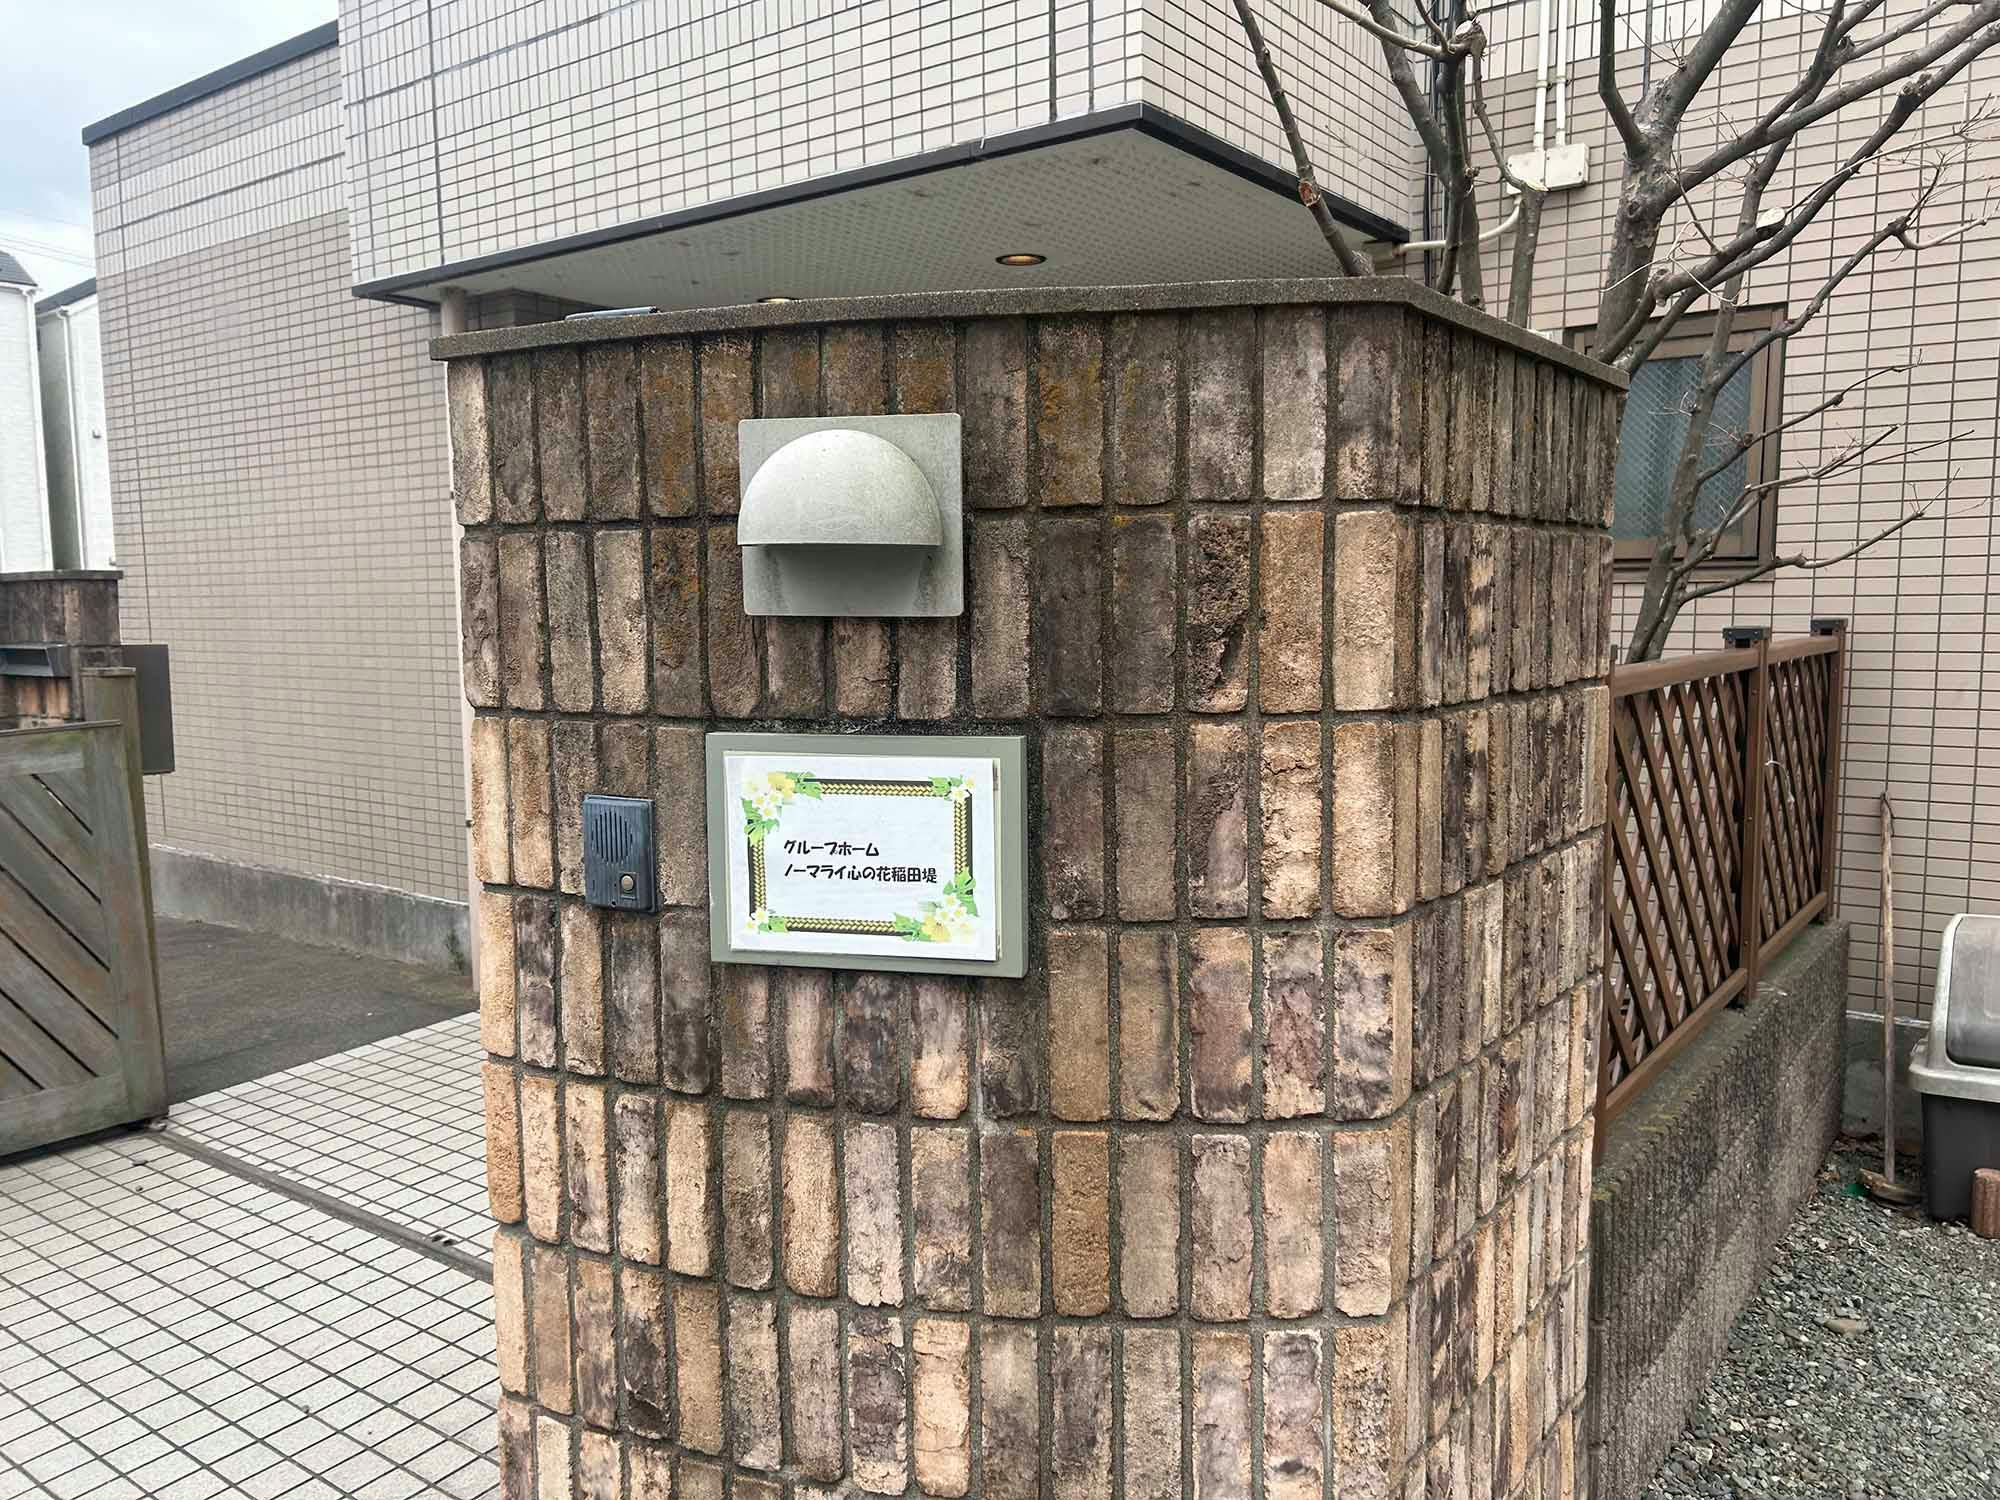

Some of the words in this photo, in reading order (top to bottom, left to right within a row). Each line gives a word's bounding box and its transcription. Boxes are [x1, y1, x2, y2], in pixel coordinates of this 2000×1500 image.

[783, 839, 880, 857] グループホーム
[784, 863, 938, 884] ノーマライ心の花稲田堤
